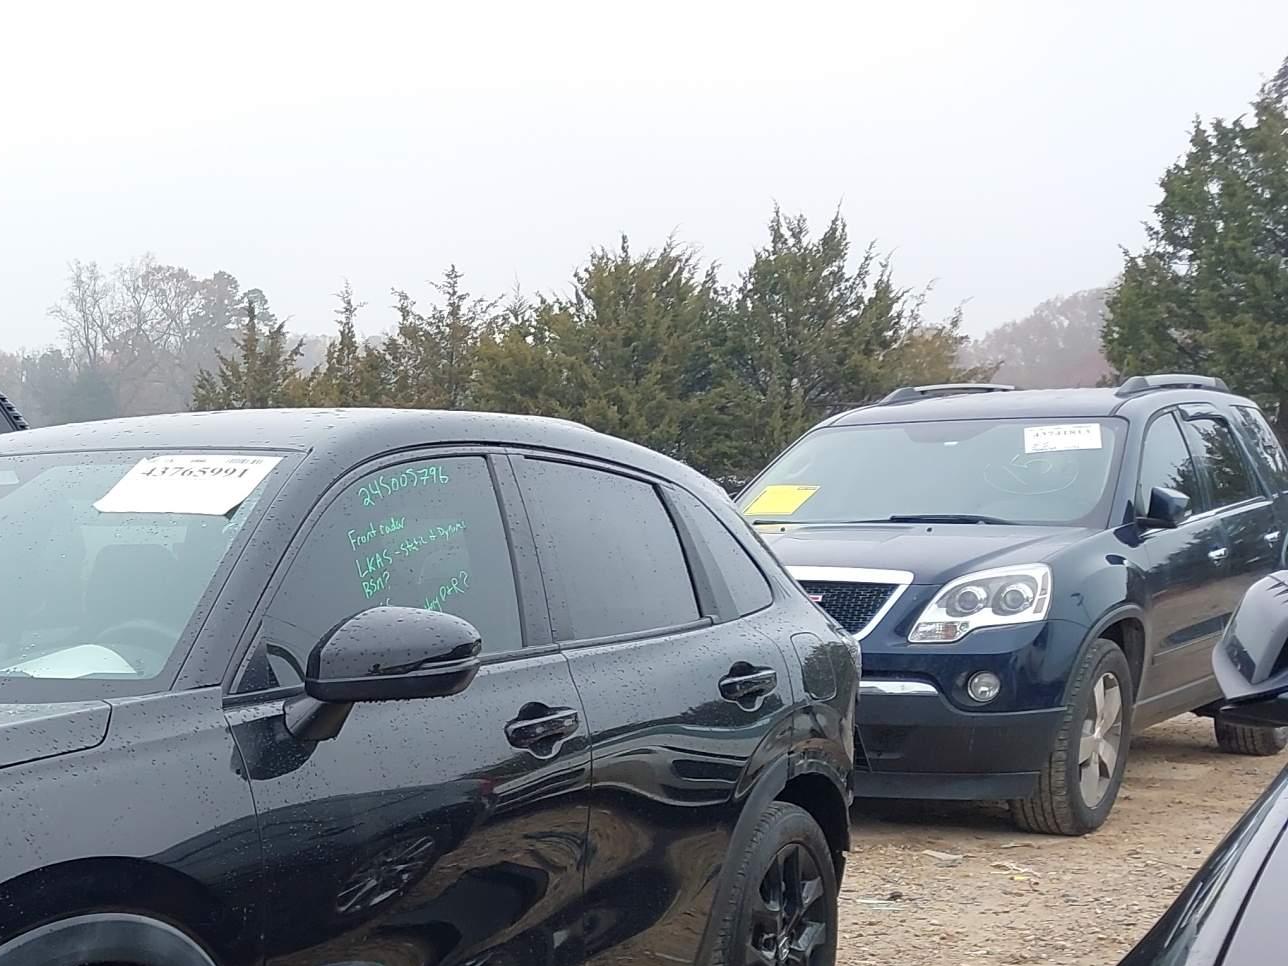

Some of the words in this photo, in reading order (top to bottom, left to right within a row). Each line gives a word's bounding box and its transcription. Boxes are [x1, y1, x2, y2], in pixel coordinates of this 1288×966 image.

[141, 466, 250, 479] 43765991
[347, 522, 377, 551] Front
[355, 549, 393, 578] LKAS
